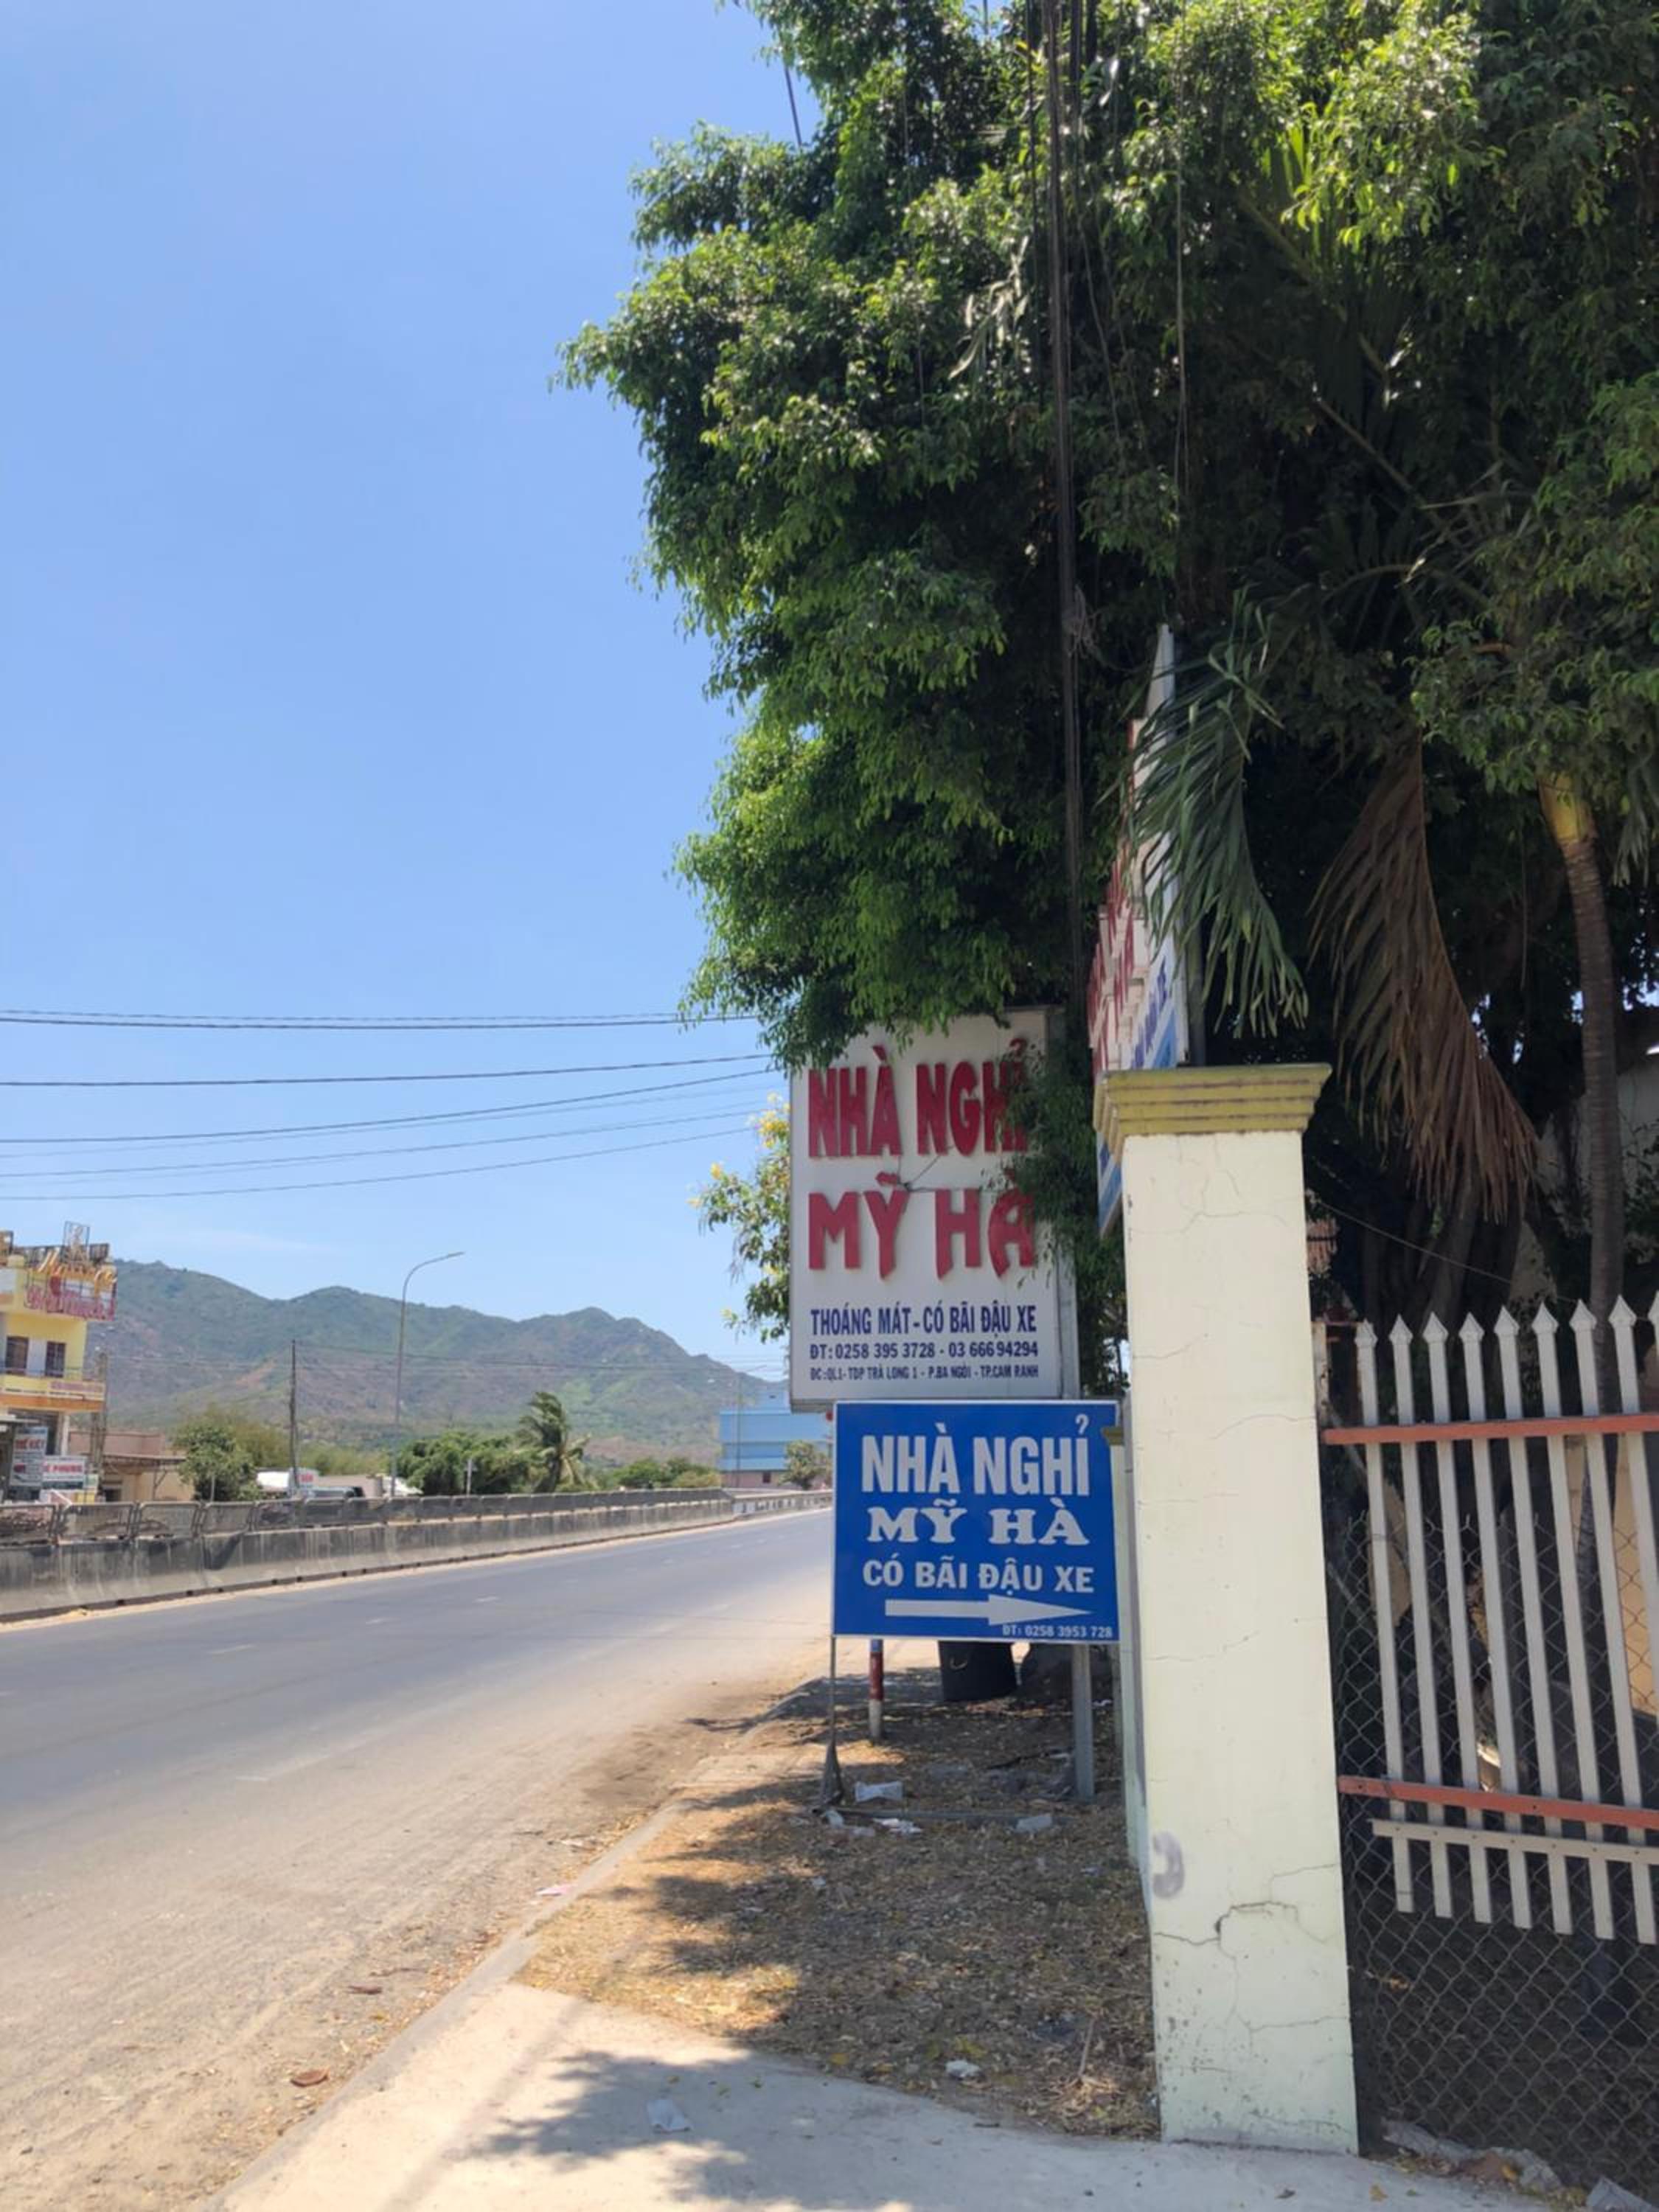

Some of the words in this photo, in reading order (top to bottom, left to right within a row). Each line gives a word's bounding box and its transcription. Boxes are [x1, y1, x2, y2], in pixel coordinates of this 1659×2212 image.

[809, 1045, 902, 1158] NHÀ
[809, 1171, 911, 1280] MỸ
[810, 1301, 872, 1336] THOÁNG
[877, 1301, 912, 1335] MÁT
[922, 1299, 945, 1334] CÓ
[949, 1301, 975, 1334] BÃI
[980, 1299, 1012, 1338] ĐẬU
[1016, 1304, 1037, 1333] XE
[873, 1342, 899, 1359] 395
[902, 1342, 936, 1359] 3728
[948, 1342, 967, 1358] 03
[886, 1366, 911, 1380] LONG
[911, 1366, 918, 1380] 1
[861, 1422, 961, 1494] NHÀ
[972, 1413, 1090, 1496] NGHỈ
[866, 1498, 967, 1544] MỸ
[988, 1497, 1091, 1545] HÀ
[862, 1552, 904, 1587] CÓ
[914, 1555, 968, 1589] BÃI
[978, 1557, 1043, 1596] ĐẬU
[1054, 1565, 1095, 1593] XE
[1024, 1624, 1055, 1638] 0258
[1057, 1625, 1088, 1638] 3953
[1091, 1626, 1113, 1638] 728
